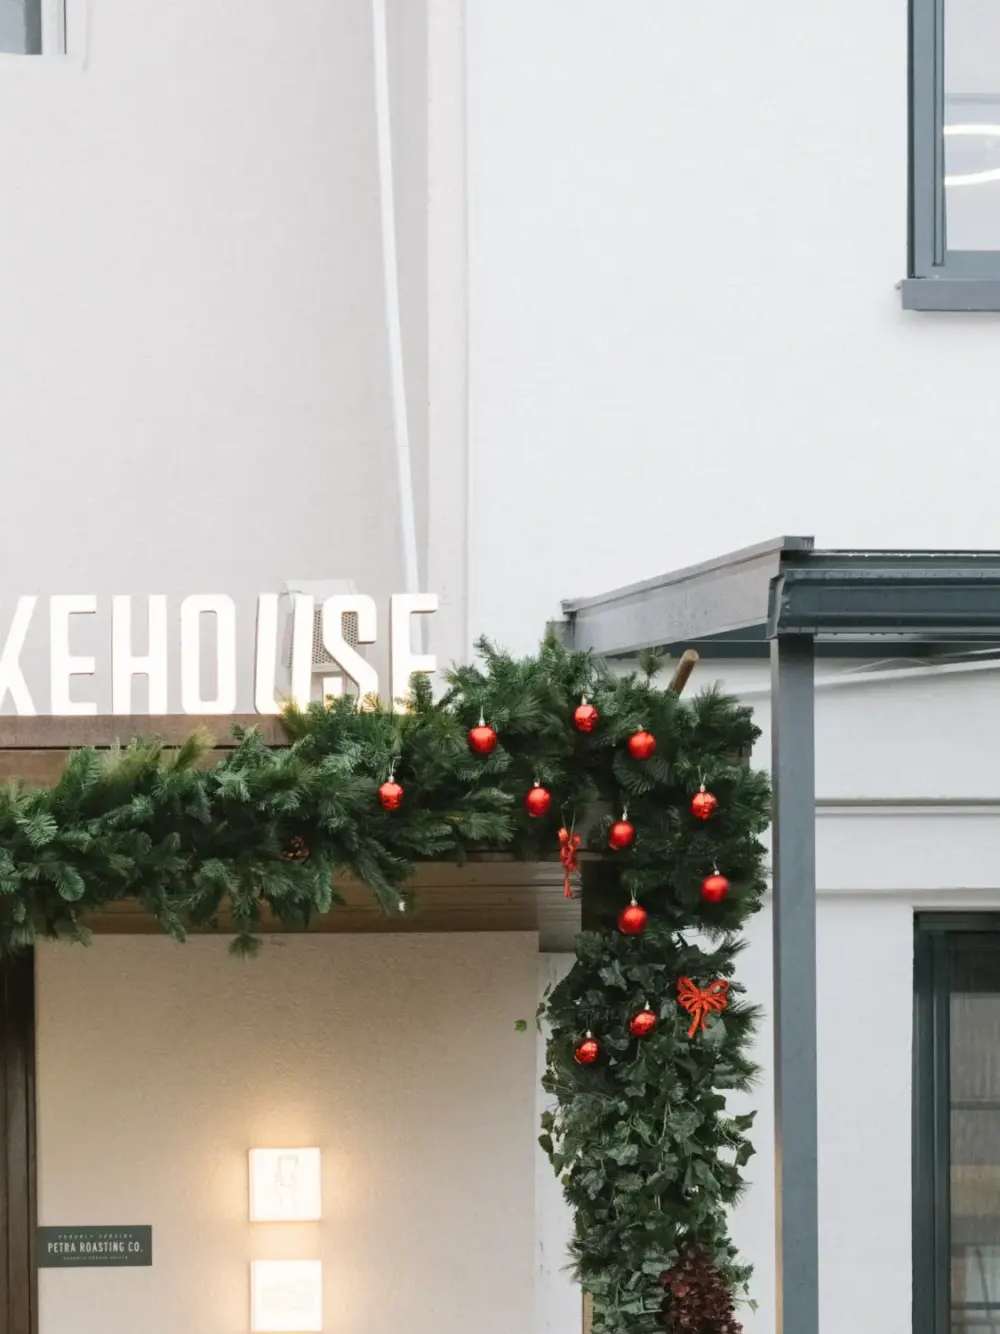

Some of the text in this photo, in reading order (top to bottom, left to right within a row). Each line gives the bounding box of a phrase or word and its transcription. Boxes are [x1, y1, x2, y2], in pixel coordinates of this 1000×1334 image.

[47, 1241, 143, 1253] PETRA ROASTING CO.
